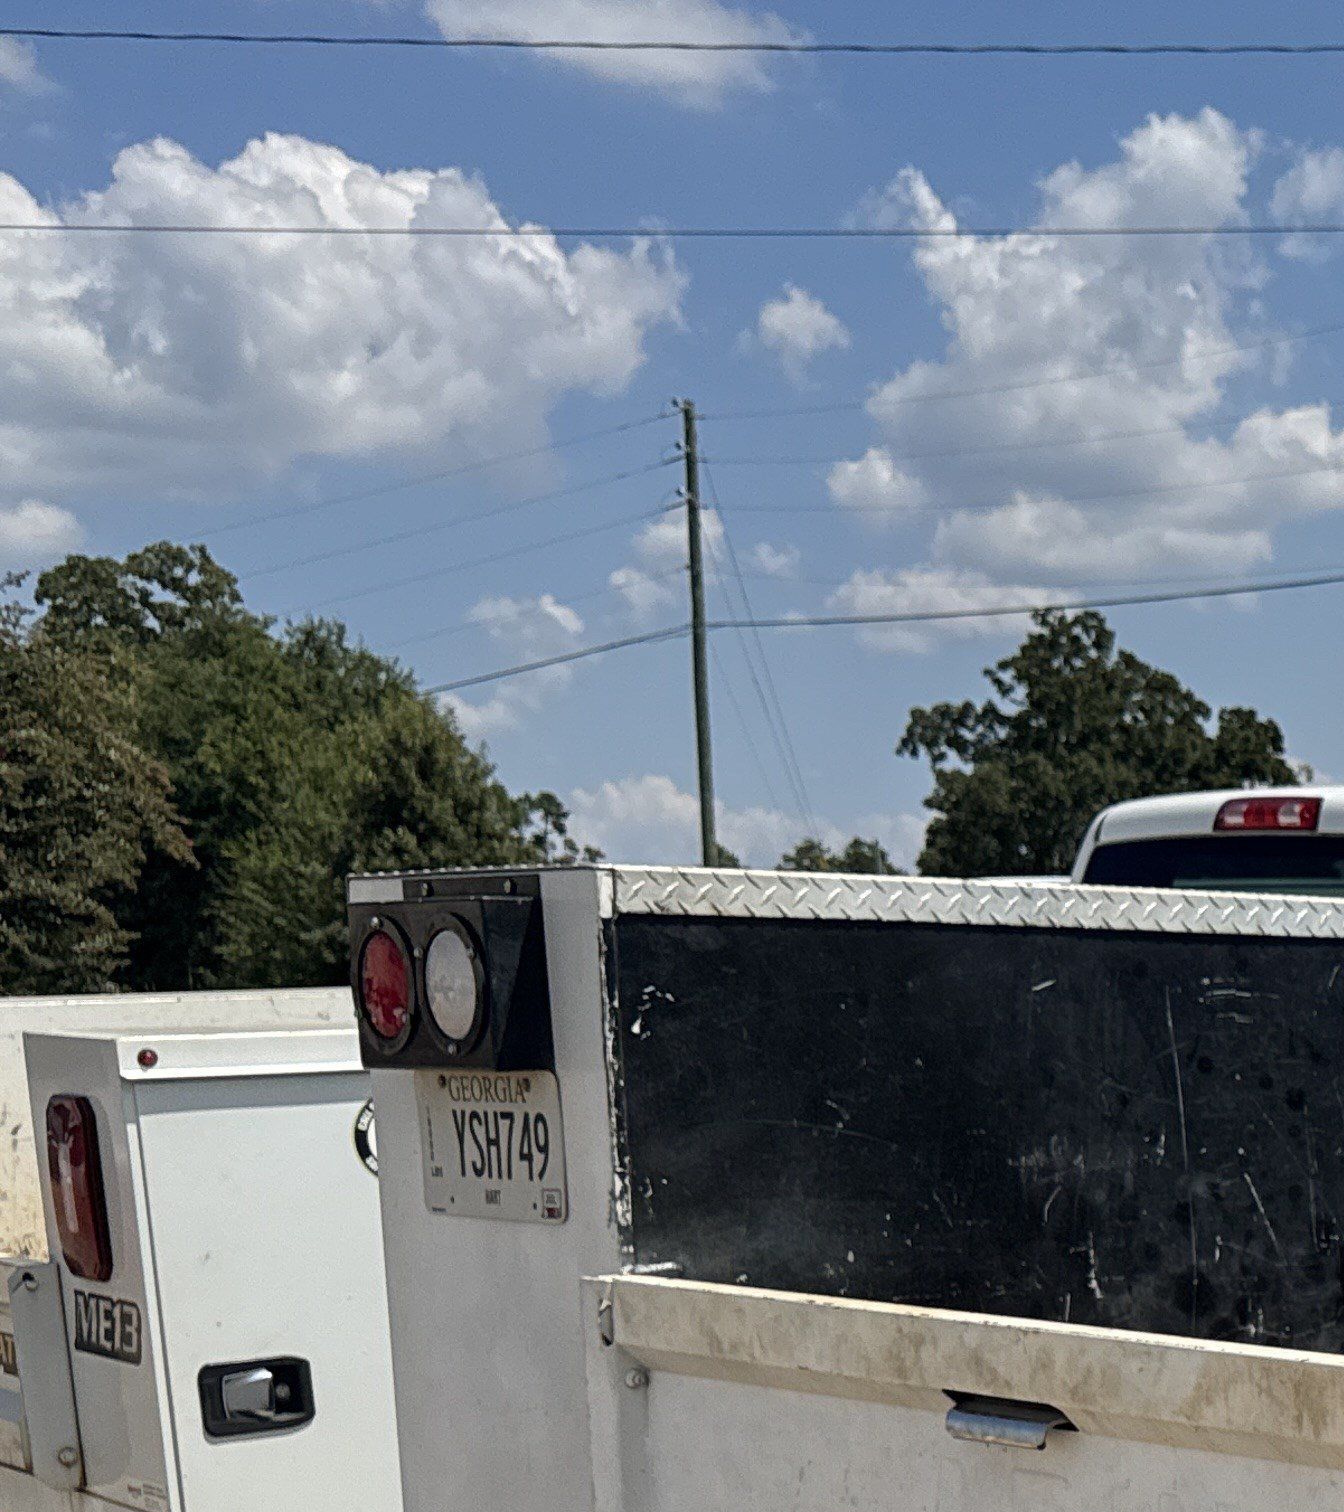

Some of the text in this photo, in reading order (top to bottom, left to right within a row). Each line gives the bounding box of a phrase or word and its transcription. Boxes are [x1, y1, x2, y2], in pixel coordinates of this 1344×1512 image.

[449, 1074, 527, 1104] GEORGIA
[451, 1108, 549, 1181] YSH749
[75, 1290, 141, 1358] ME13
